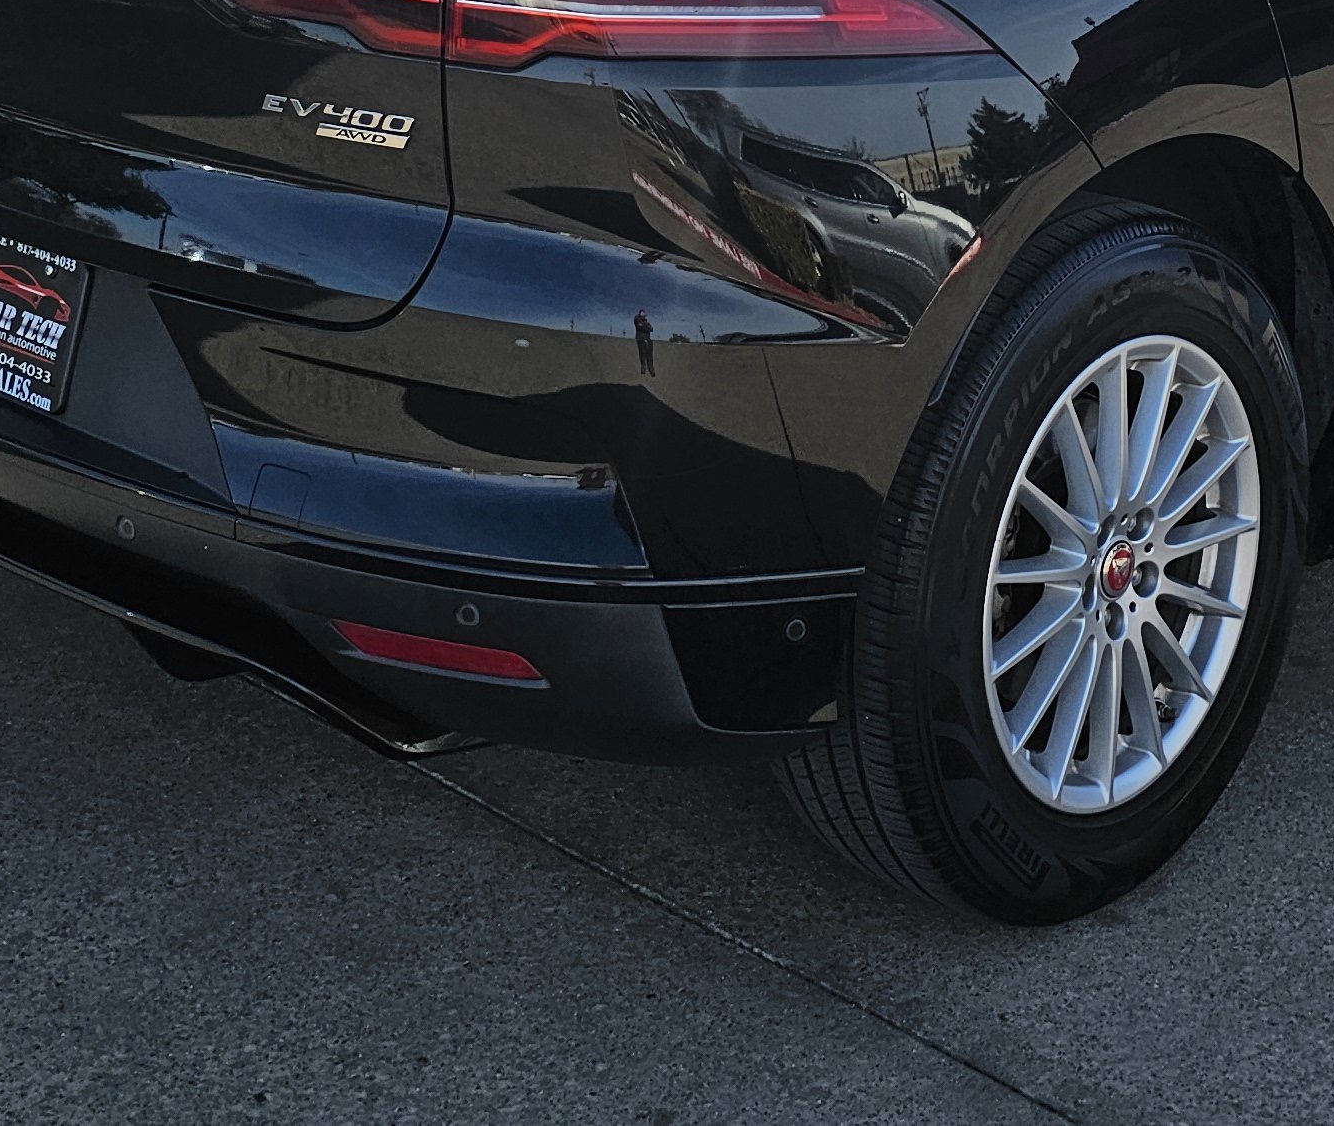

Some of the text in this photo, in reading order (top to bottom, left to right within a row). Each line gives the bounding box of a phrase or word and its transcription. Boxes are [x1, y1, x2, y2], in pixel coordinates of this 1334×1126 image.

[262, 93, 415, 133] EV400
[335, 128, 387, 145] AWD
[17, 241, 77, 272] 817-404-4033
[19, 310, 67, 350] TECH
[7, 332, 57, 361] automotive
